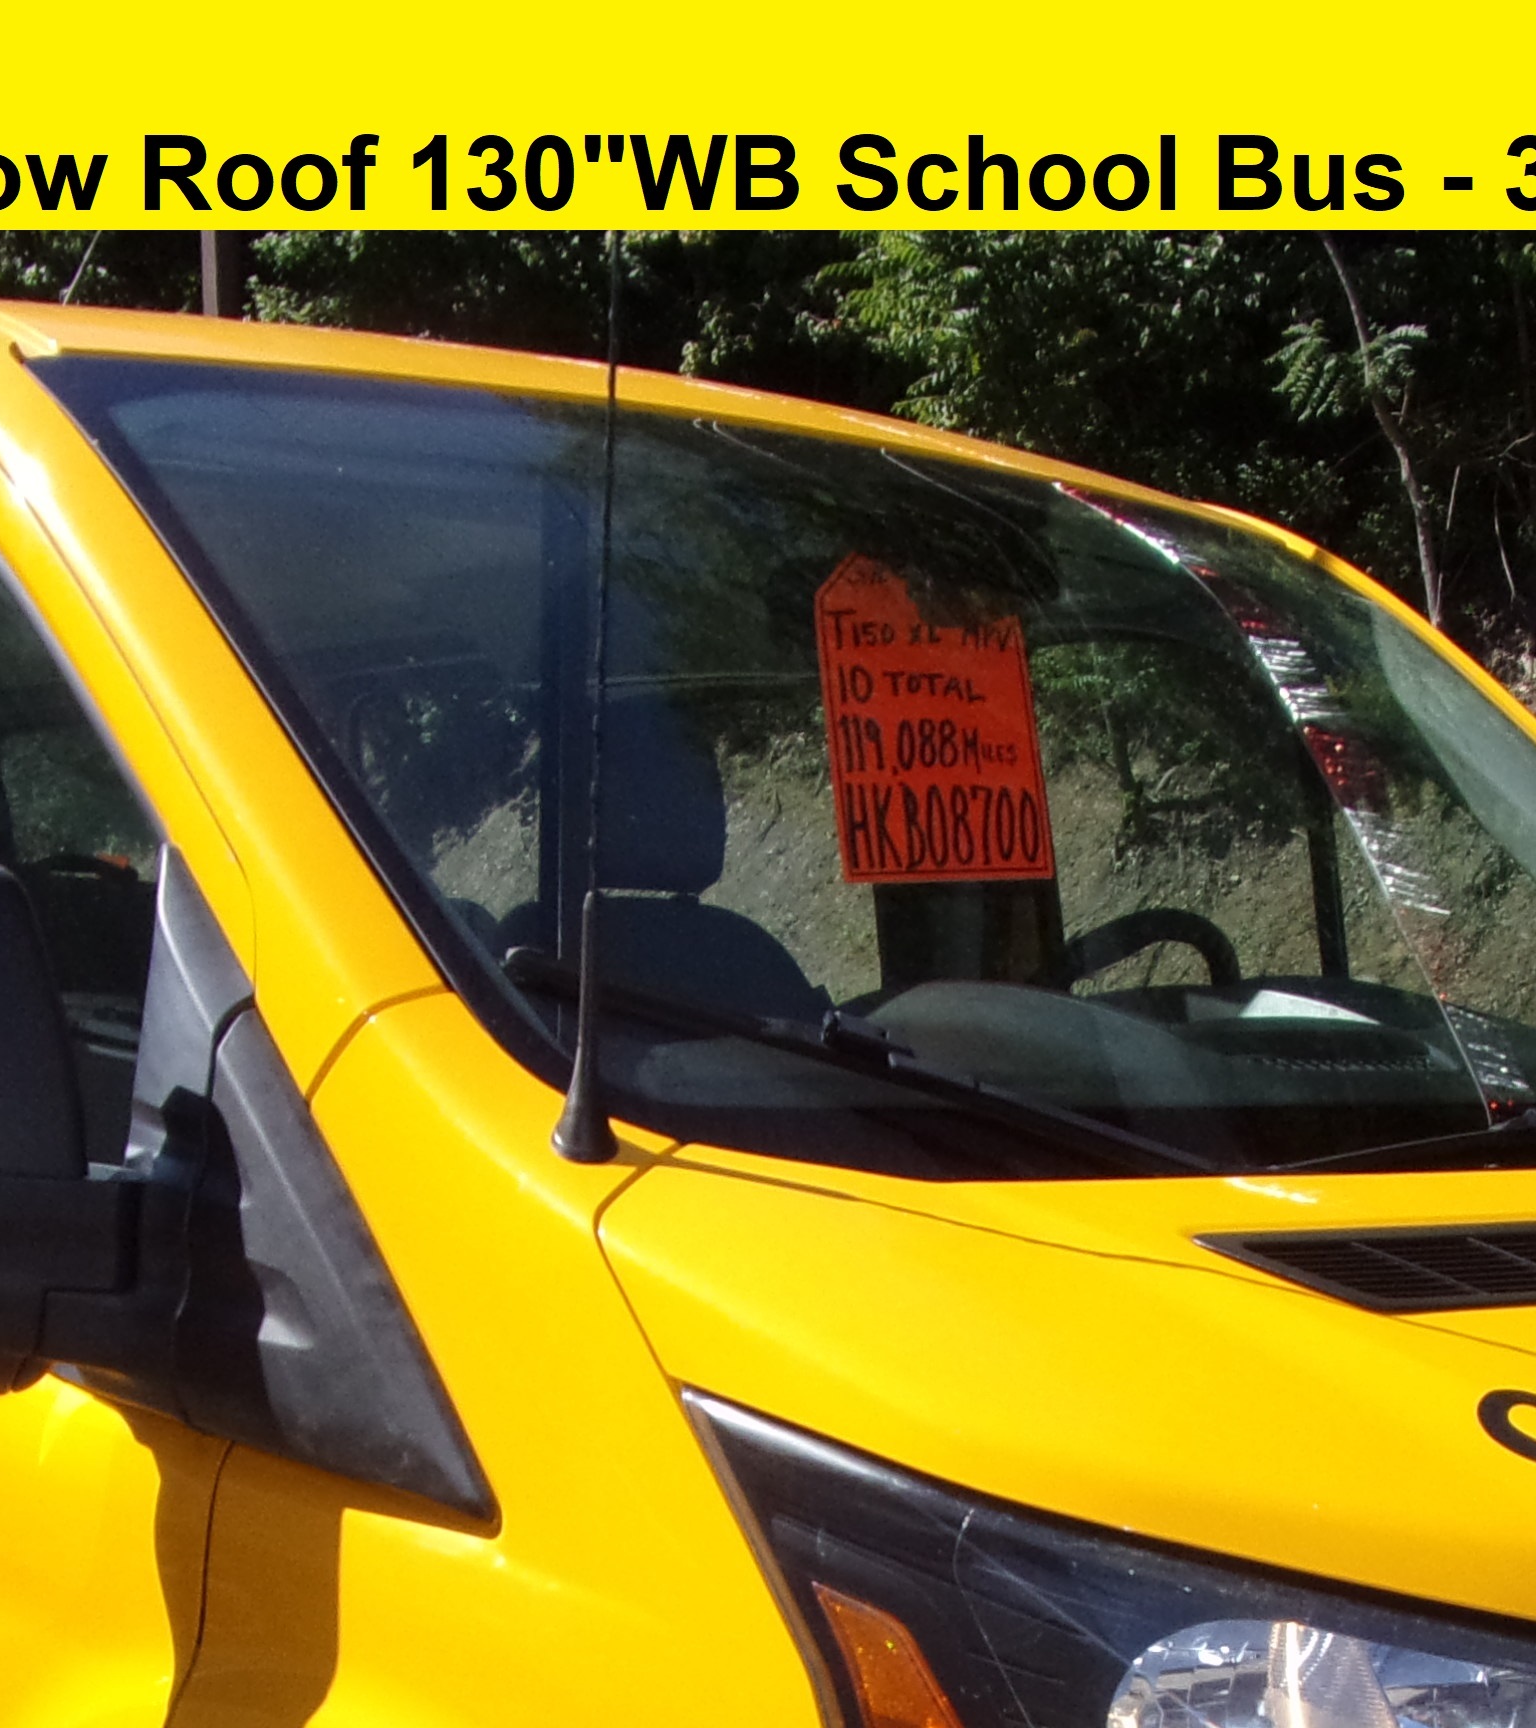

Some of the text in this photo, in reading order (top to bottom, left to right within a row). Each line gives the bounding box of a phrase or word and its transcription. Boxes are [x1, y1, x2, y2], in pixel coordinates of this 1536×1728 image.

[823, 607, 895, 650] T150
[837, 664, 987, 705] 10 TOTAL
[837, 713, 959, 777] 119,088
[844, 780, 1041, 872] HKB08700
